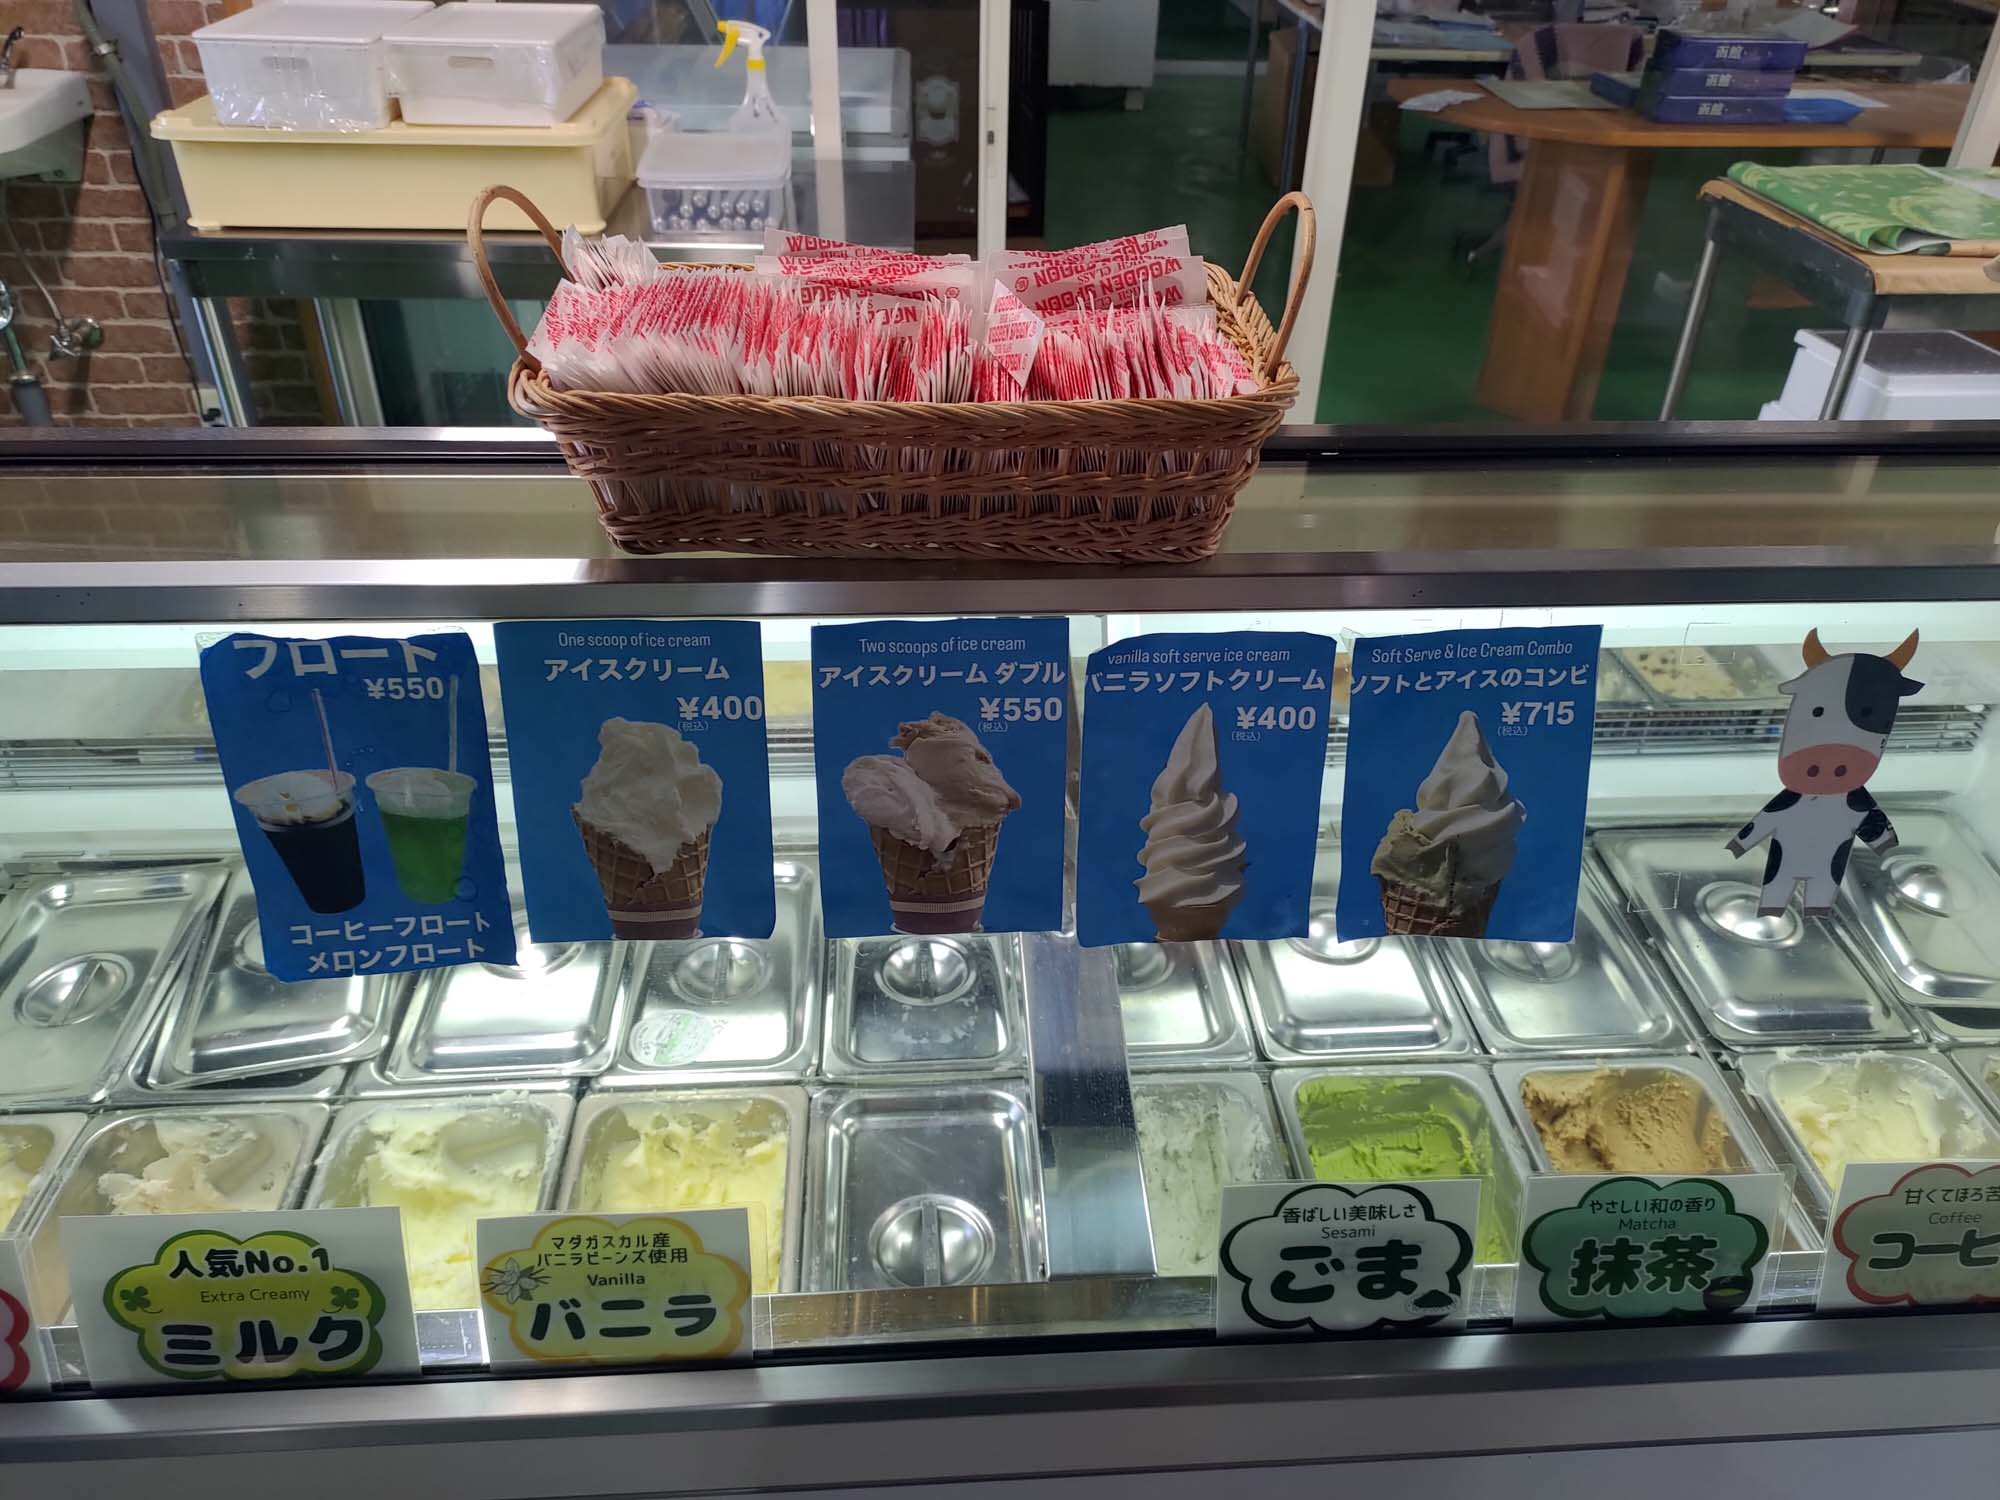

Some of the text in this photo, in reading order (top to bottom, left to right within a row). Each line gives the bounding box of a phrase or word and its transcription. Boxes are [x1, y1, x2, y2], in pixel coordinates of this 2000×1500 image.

[558, 632, 711, 649] One scoop of ice cream
[859, 637, 1026, 657] Two scoops of ice cream
[1372, 639, 1573, 664] Soft Serve & Ice Cream Combo
[233, 638, 438, 679] フロート
[1107, 648, 1290, 665] vanilla soft serve ice cream
[544, 657, 730, 682] アイスクリーム
[818, 660, 1066, 689] アイスクリーム ダブル
[1350, 663, 1590, 695] ソフトとアイスのコンビ
[363, 676, 444, 700] ¥550
[676, 694, 764, 721] ¥400
[978, 696, 1063, 722] ¥550
[1236, 705, 1317, 731] ¥400
[1501, 700, 1575, 726] ¥715
[289, 911, 491, 945] コーヒーフロート
[307, 937, 486, 974] メロンフロート
[1282, 1203, 1417, 1224] 香ばしい美味しさ
[1589, 1197, 1716, 1215] やさしい和の香り
[1928, 1211, 1982, 1225] Coffee
[1321, 1225, 1376, 1239] Sesami
[1618, 1218, 1677, 1231] Matcha
[551, 1231, 671, 1251] マダガスカル産
[169, 1247, 331, 1280] 人気No.1
[536, 1247, 688, 1268] バニラビーンズ使用
[1570, 1234, 1718, 1296] 抹茶
[587, 1272, 646, 1288] Vanilla
[1270, 1239, 1423, 1304] ごま
[200, 1288, 310, 1305] Extra Creamy
[530, 1294, 717, 1341] バニラ
[161, 1316, 364, 1366] ミルク
